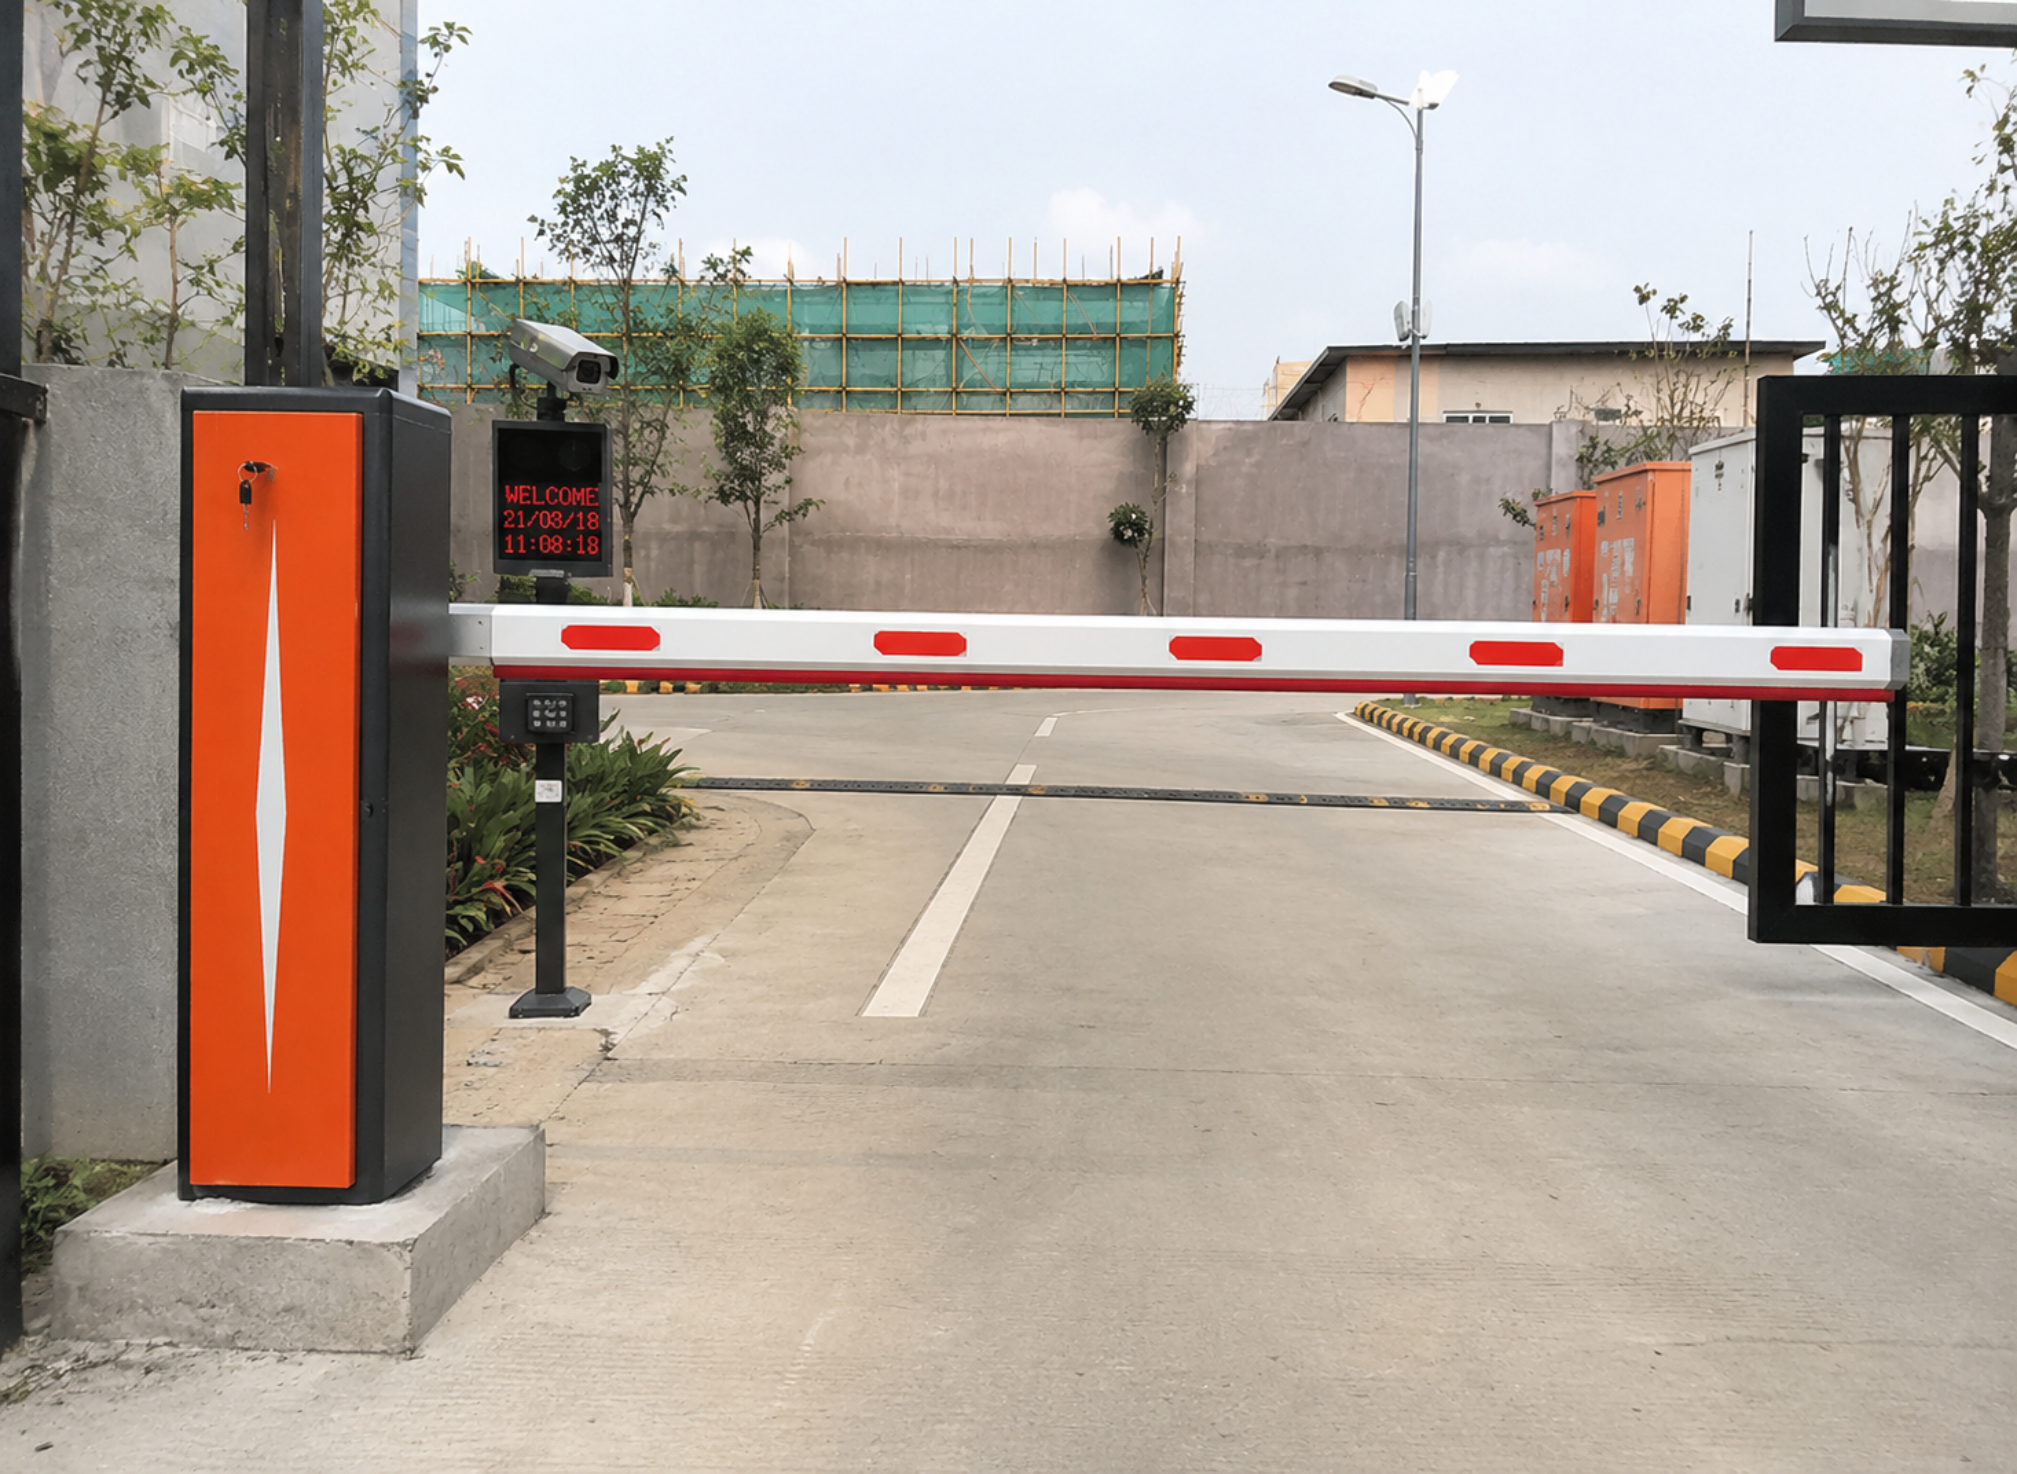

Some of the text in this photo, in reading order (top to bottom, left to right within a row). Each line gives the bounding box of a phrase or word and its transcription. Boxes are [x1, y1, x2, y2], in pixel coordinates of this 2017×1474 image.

[504, 485, 600, 507] WELCOME
[503, 509, 600, 530] 21/03/18
[504, 534, 600, 555] 11:08:18
